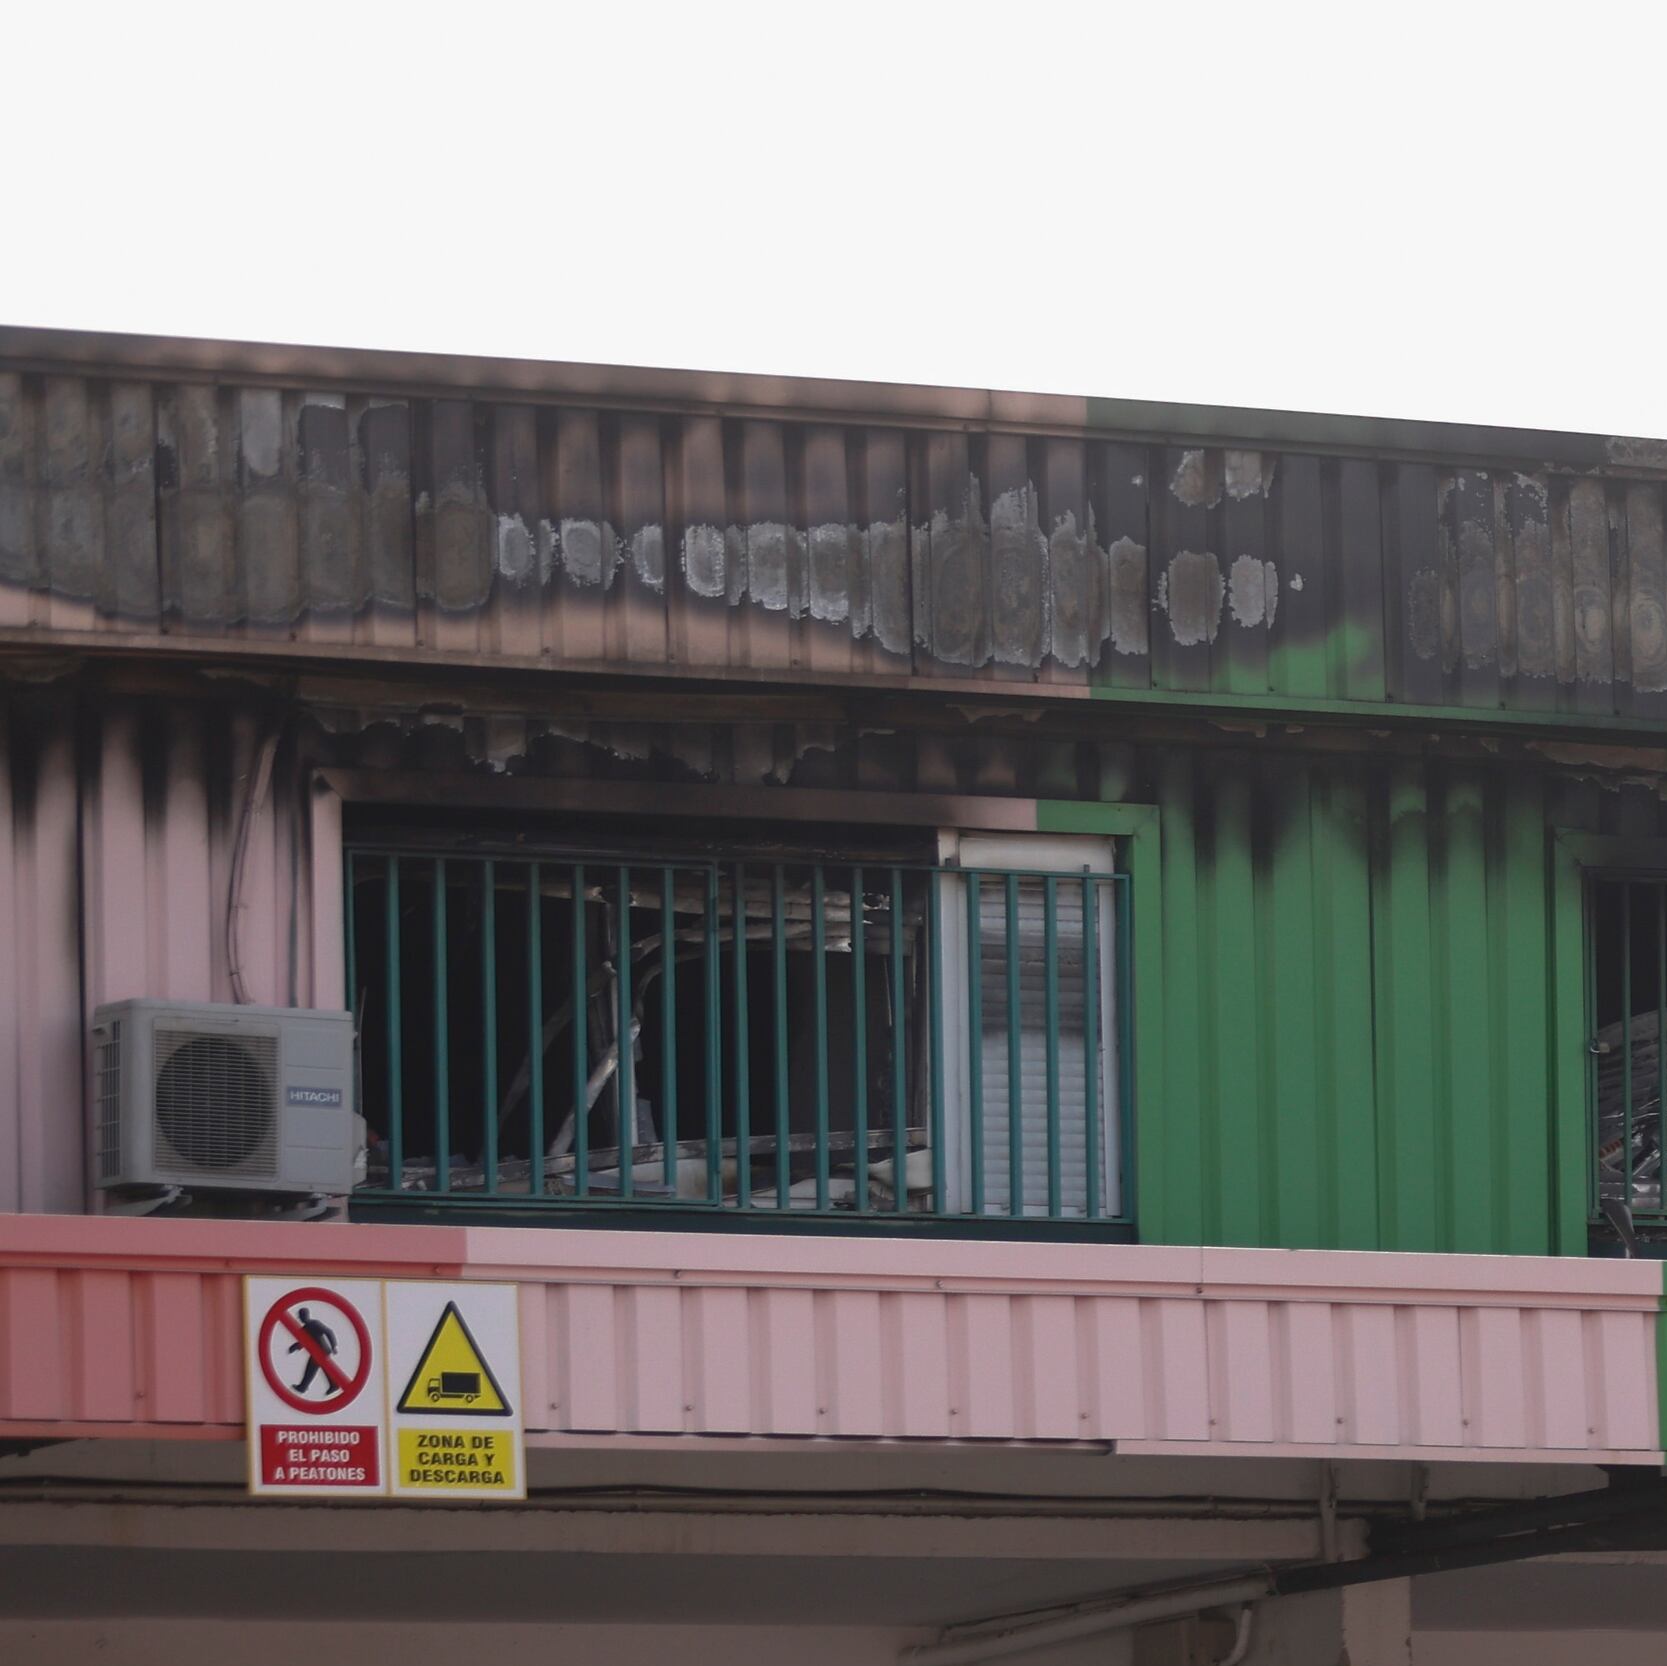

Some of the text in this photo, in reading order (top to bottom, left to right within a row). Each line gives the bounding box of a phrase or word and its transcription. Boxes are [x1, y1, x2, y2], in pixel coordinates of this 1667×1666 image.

[290, 1091, 340, 1103] HITACHI
[277, 1431, 361, 1444] PROHIBIDO
[418, 1434, 494, 1450] ZONA DE
[289, 1449, 350, 1463] EL PASO
[418, 1451, 496, 1467] CARGA Y
[274, 1467, 366, 1482] A PEATONES
[409, 1468, 505, 1485] DESCARGA
